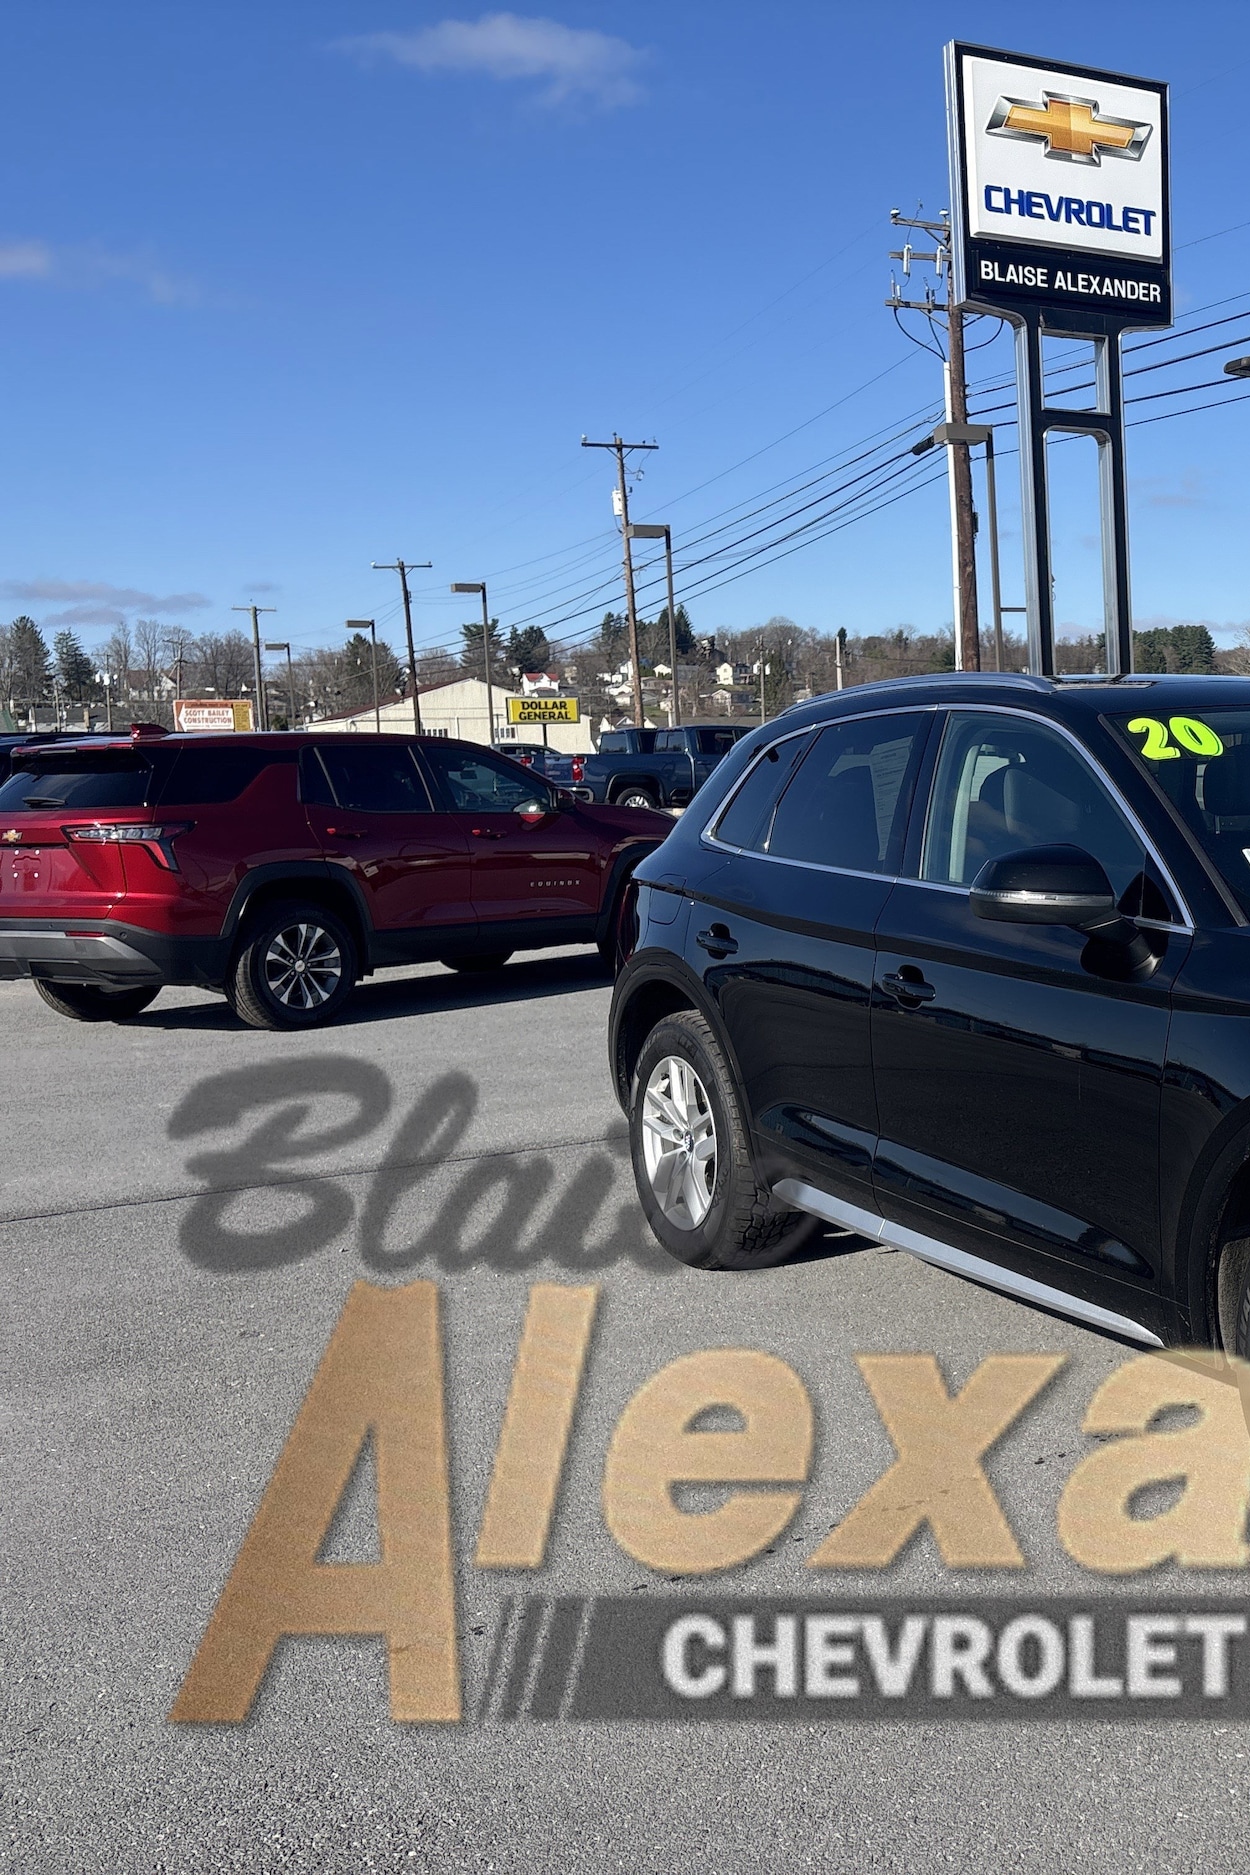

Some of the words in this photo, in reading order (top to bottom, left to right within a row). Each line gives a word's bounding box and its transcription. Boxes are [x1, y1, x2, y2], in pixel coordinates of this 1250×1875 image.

[984, 184, 1157, 236] CHEVROLET
[980, 259, 1048, 288] BLAISE
[1054, 271, 1161, 303] ALEXANDER
[518, 711, 571, 720] GENERAL
[521, 701, 567, 710] DOLLAR
[1127, 717, 1224, 760] 20
